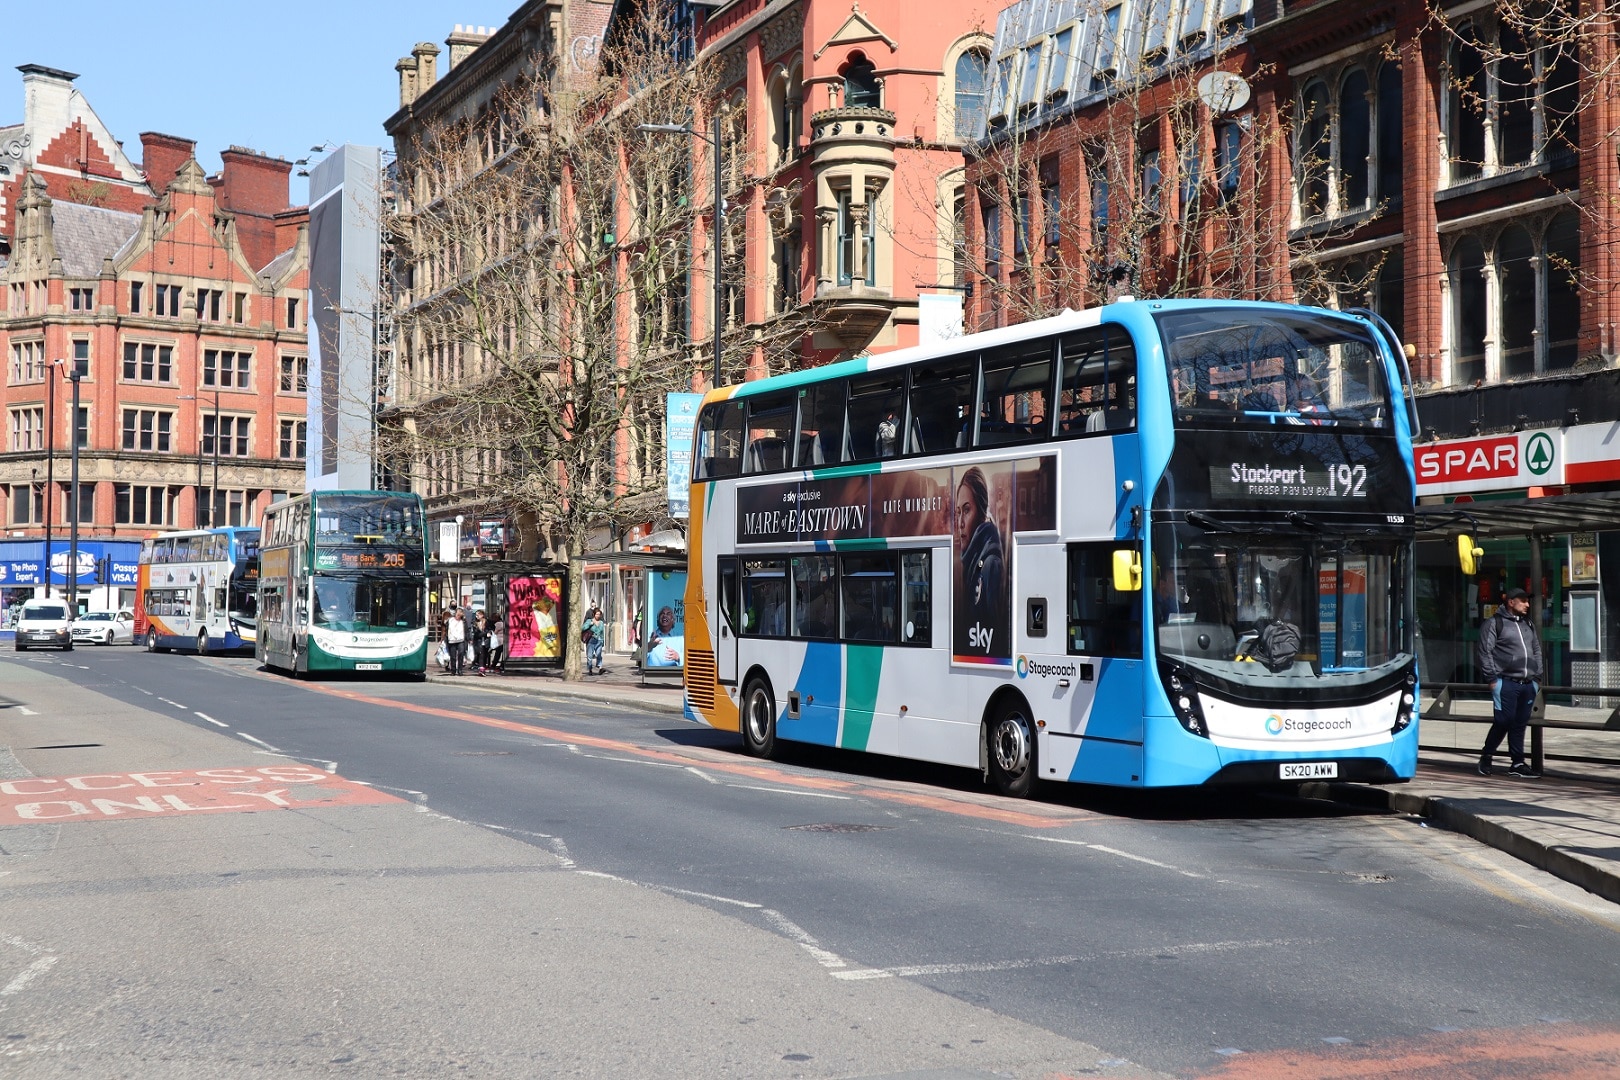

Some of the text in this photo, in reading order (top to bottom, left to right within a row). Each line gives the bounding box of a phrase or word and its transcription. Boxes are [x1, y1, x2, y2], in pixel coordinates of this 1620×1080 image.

[1420, 444, 1516, 477] SPAR
[1231, 462, 1367, 497] Stockport 192
[782, 489, 821, 504] a sky exclusive
[1302, 486, 1314, 496] by
[883, 496, 942, 514] KATE WINSLET
[743, 504, 867, 536] MARE of EASTTOWN
[1386, 515, 1405, 524] 11538
[1573, 537, 1595, 545] DEALS
[11, 563, 38, 572] The Photo
[359, 553, 376, 562] Bank
[383, 553, 406, 567] 205
[15, 572, 34, 583] Expert
[112, 573, 131, 582] VISA
[513, 583, 546, 601] WRAP
[518, 606, 533, 617] THE
[511, 614, 533, 630] DAY
[968, 621, 994, 654] sky
[1029, 660, 1076, 678] Stagecoach
[1284, 717, 1352, 733] Stagecoach
[1284, 764, 1333, 777] SK20 AWW
[14, 788, 290, 820] ONLY
